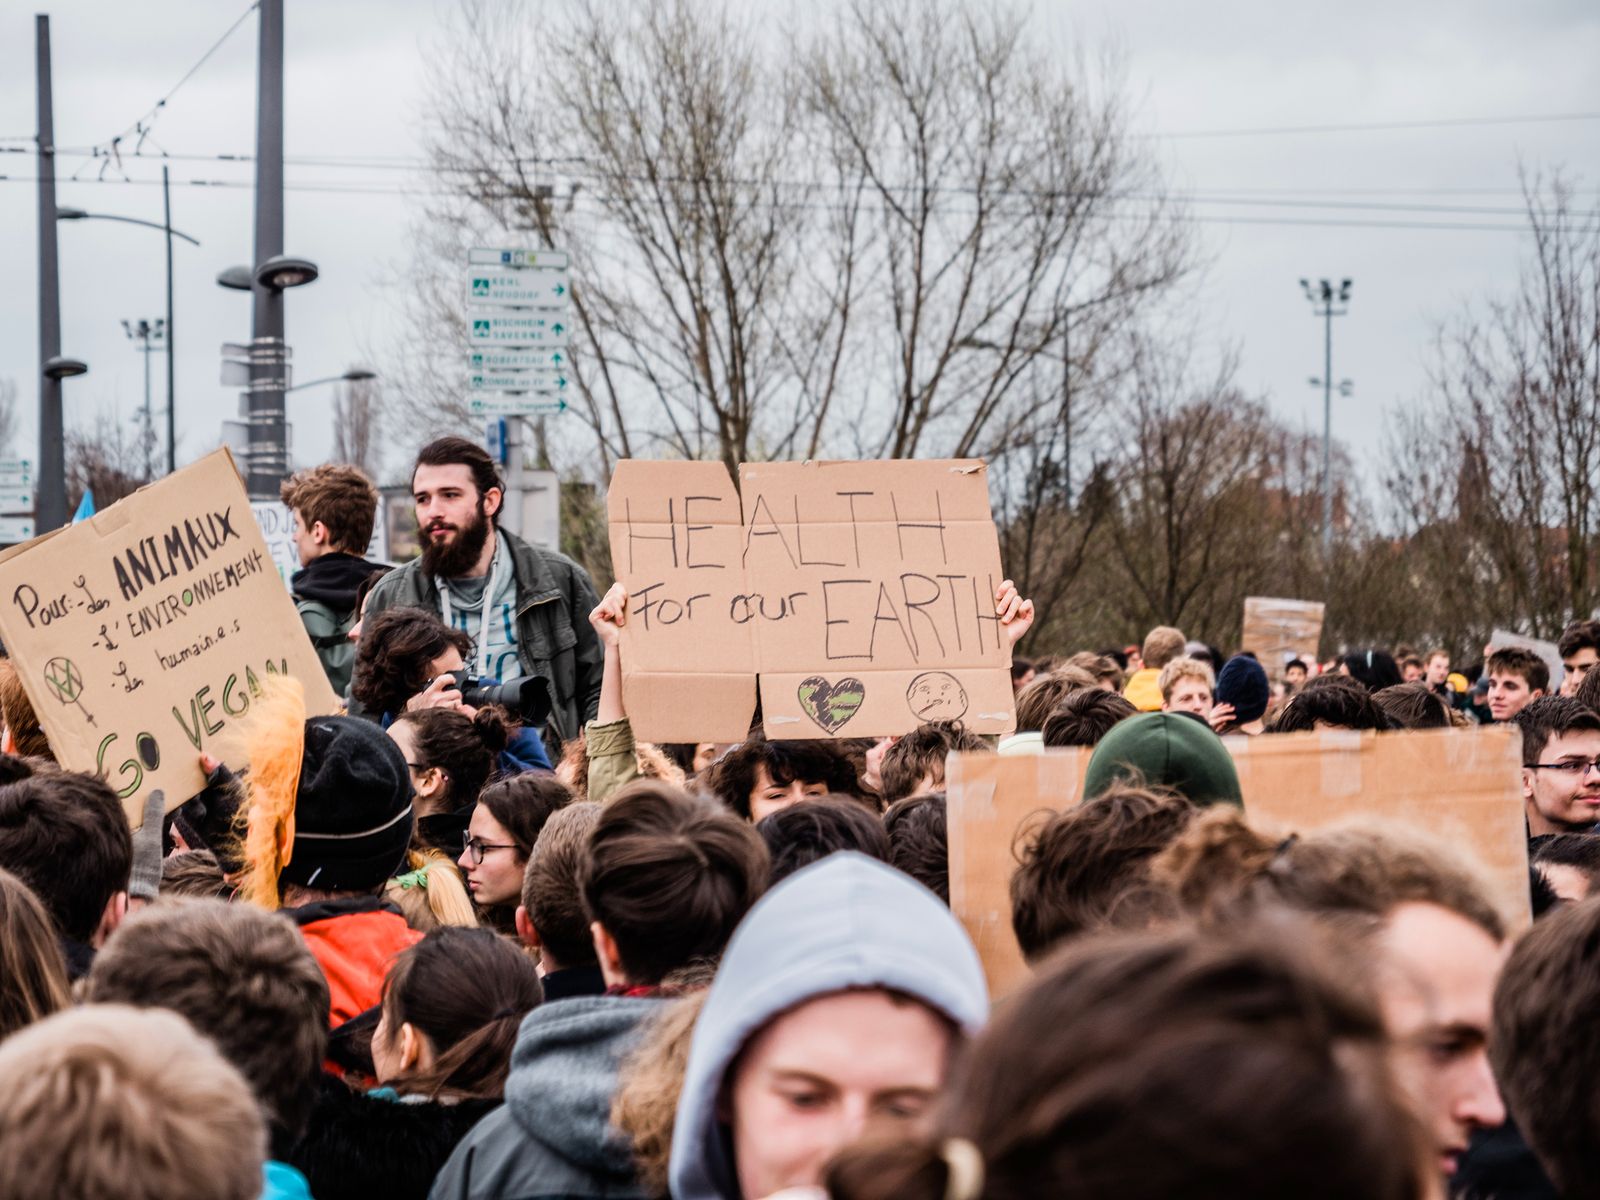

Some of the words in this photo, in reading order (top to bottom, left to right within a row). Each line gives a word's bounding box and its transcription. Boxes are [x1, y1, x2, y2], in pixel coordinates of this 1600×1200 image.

[112, 506, 240, 601] ANIMAUX
[625, 489, 947, 574] HEALTH
[630, 582, 711, 631] For
[730, 590, 809, 625] our
[822, 573, 1001, 664] EARTH
[97, 731, 161, 798] GO
